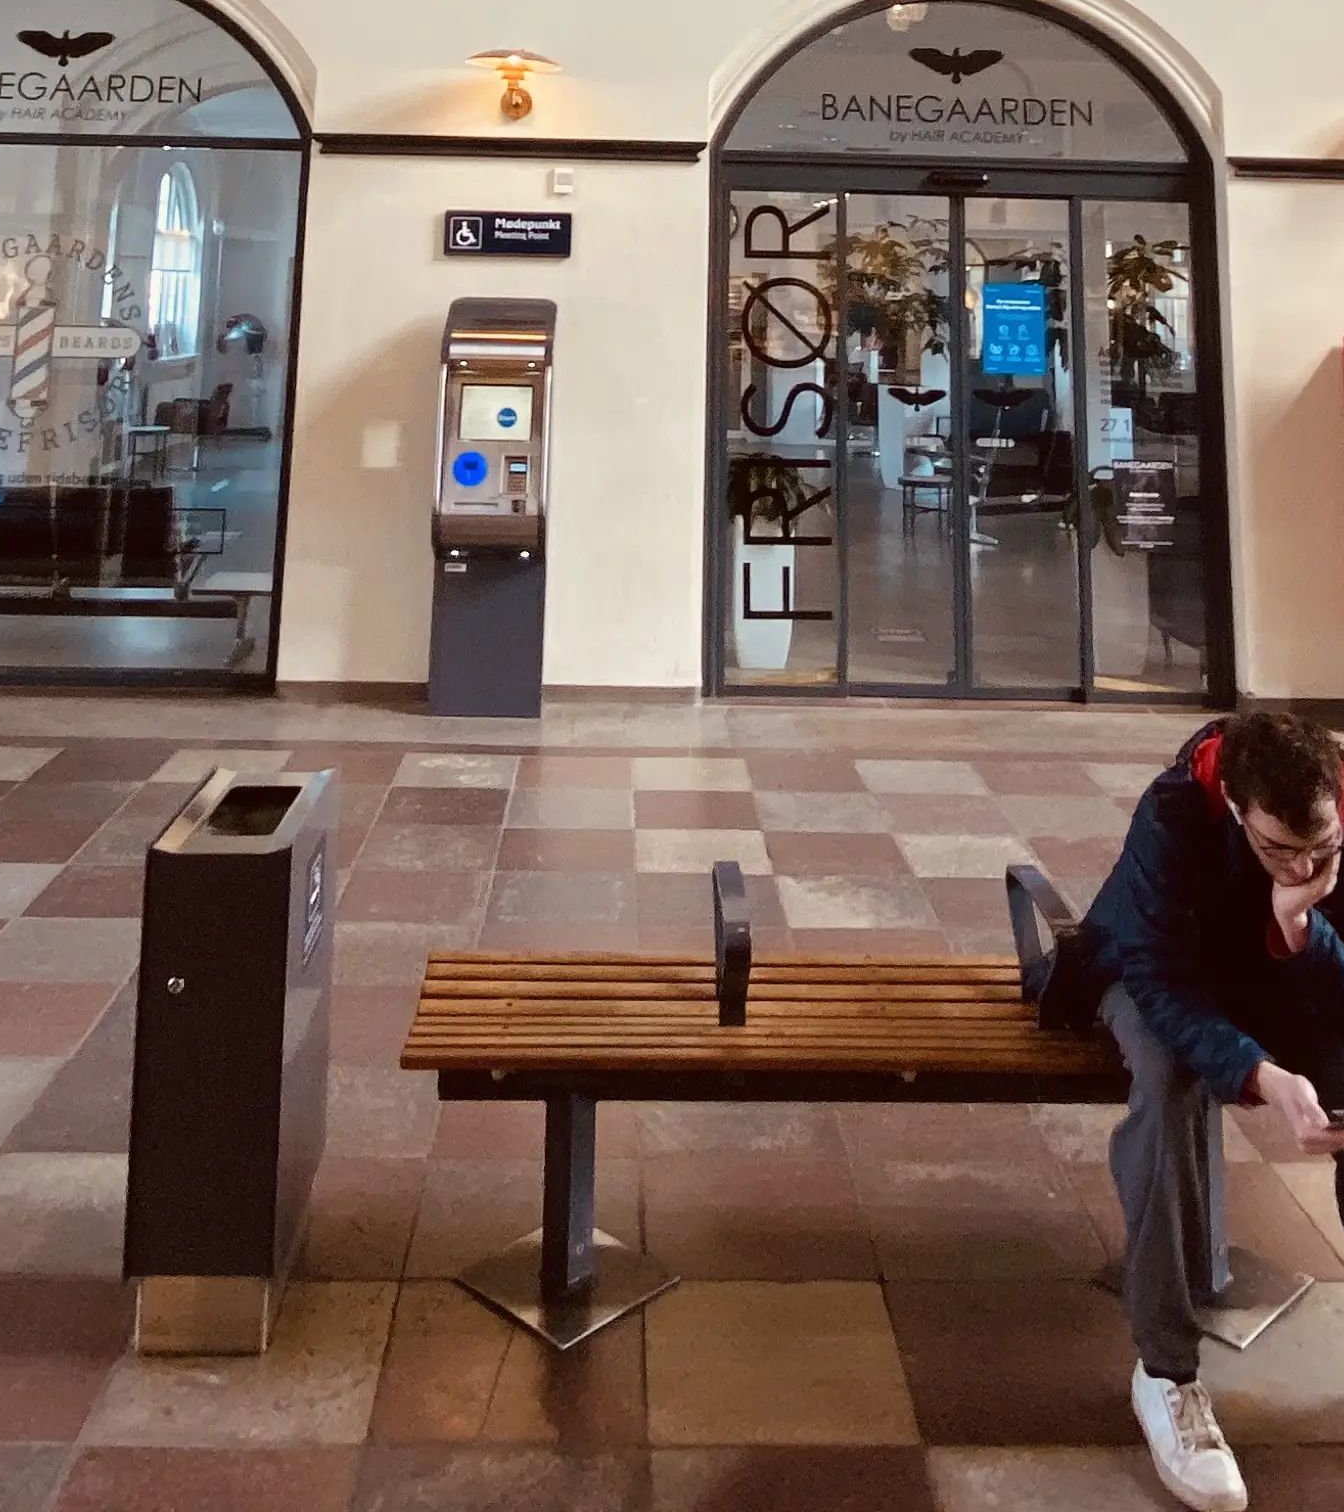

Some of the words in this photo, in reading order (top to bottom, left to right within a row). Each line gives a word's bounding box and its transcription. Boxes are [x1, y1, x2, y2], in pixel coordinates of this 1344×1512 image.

[11, 107, 46, 121] HAIR
[51, 108, 129, 122] ACADEMY
[820, 93, 1094, 126] BANEGAARDEN
[889, 130, 905, 144] by
[911, 130, 945, 143] HAIR
[949, 130, 1024, 144] ACADEMY
[494, 217, 561, 230] Mødepunkt
[59, 336, 134, 350] BEARDS
[741, 204, 834, 620] FRISØR
